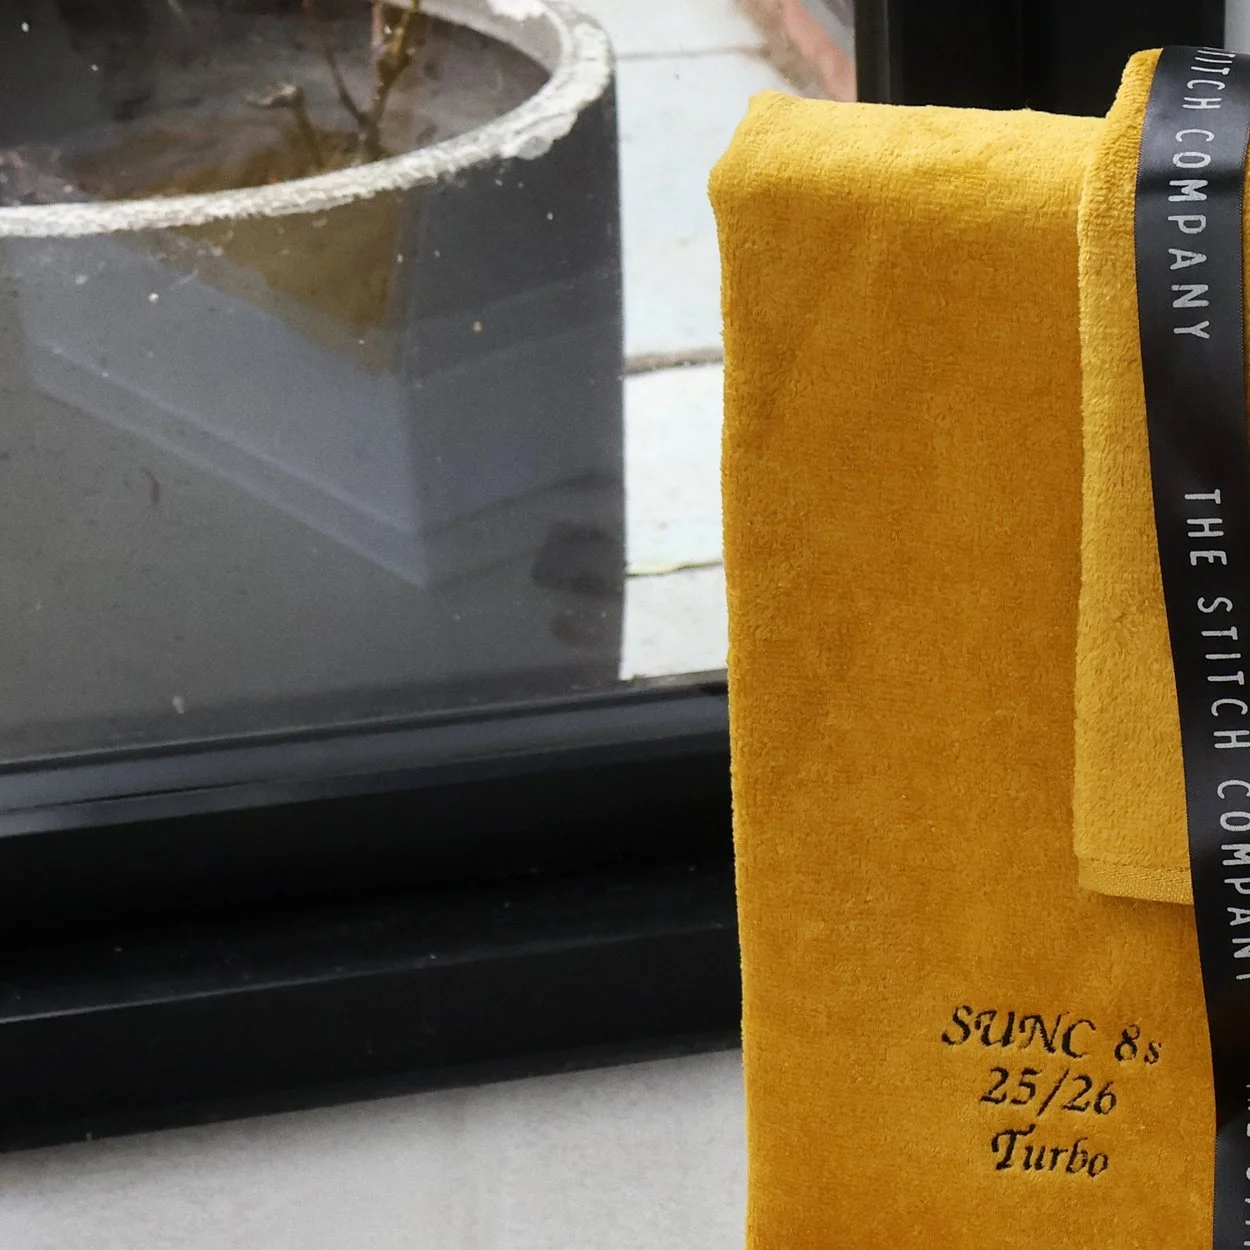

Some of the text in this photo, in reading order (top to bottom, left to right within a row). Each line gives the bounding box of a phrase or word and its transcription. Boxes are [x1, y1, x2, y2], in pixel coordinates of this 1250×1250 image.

[1168, 46, 1236, 339] TITCH COMPANY
[1184, 488, 1228, 566] THE
[941, 1005, 1162, 1065] SUNC 8s
[979, 1067, 1118, 1117] 25/26
[990, 1124, 1109, 1178] Turbo
